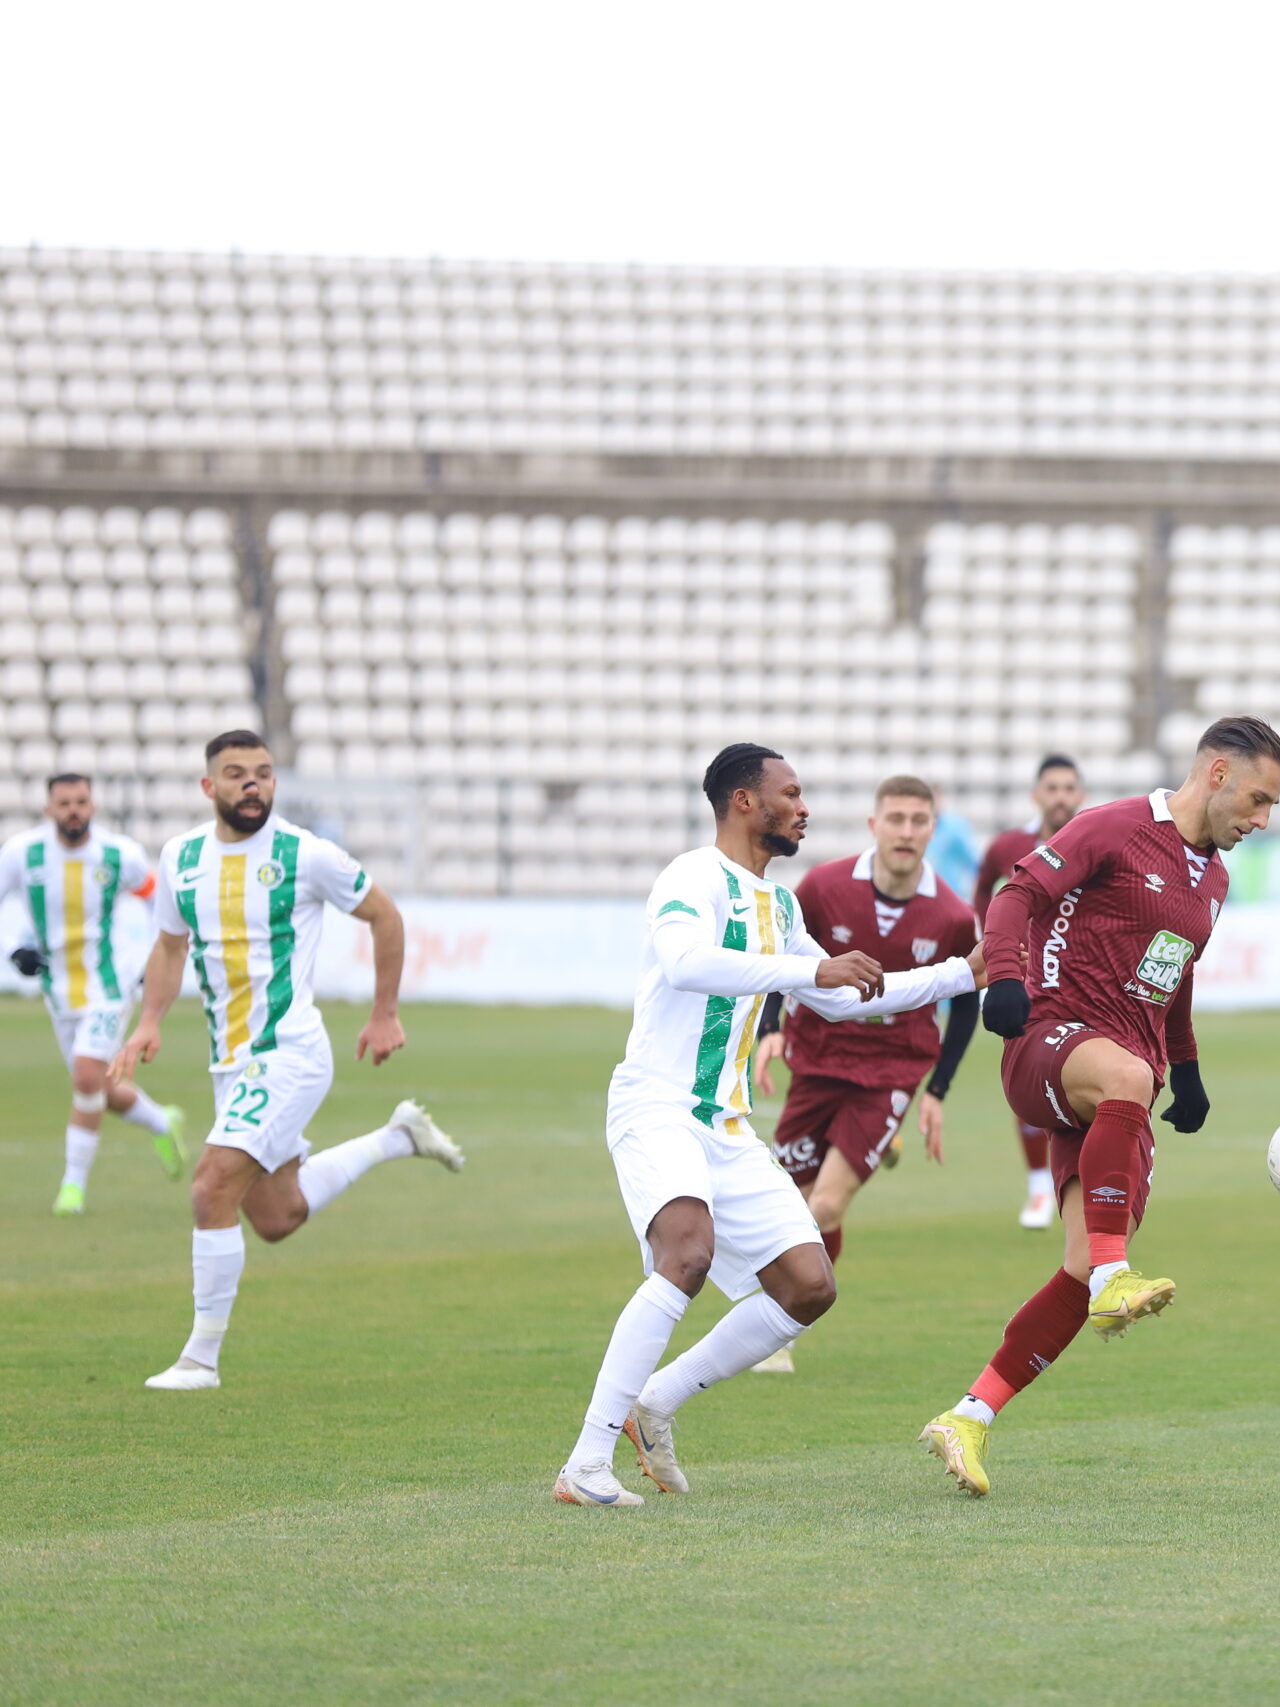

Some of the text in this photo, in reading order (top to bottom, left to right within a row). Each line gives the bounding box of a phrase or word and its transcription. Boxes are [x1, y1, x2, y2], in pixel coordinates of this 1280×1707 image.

[1151, 934, 1191, 965] tek
[1139, 960, 1180, 990] süt
[226, 1082, 269, 1127] 22
[1092, 1196, 1126, 1204] umbro
